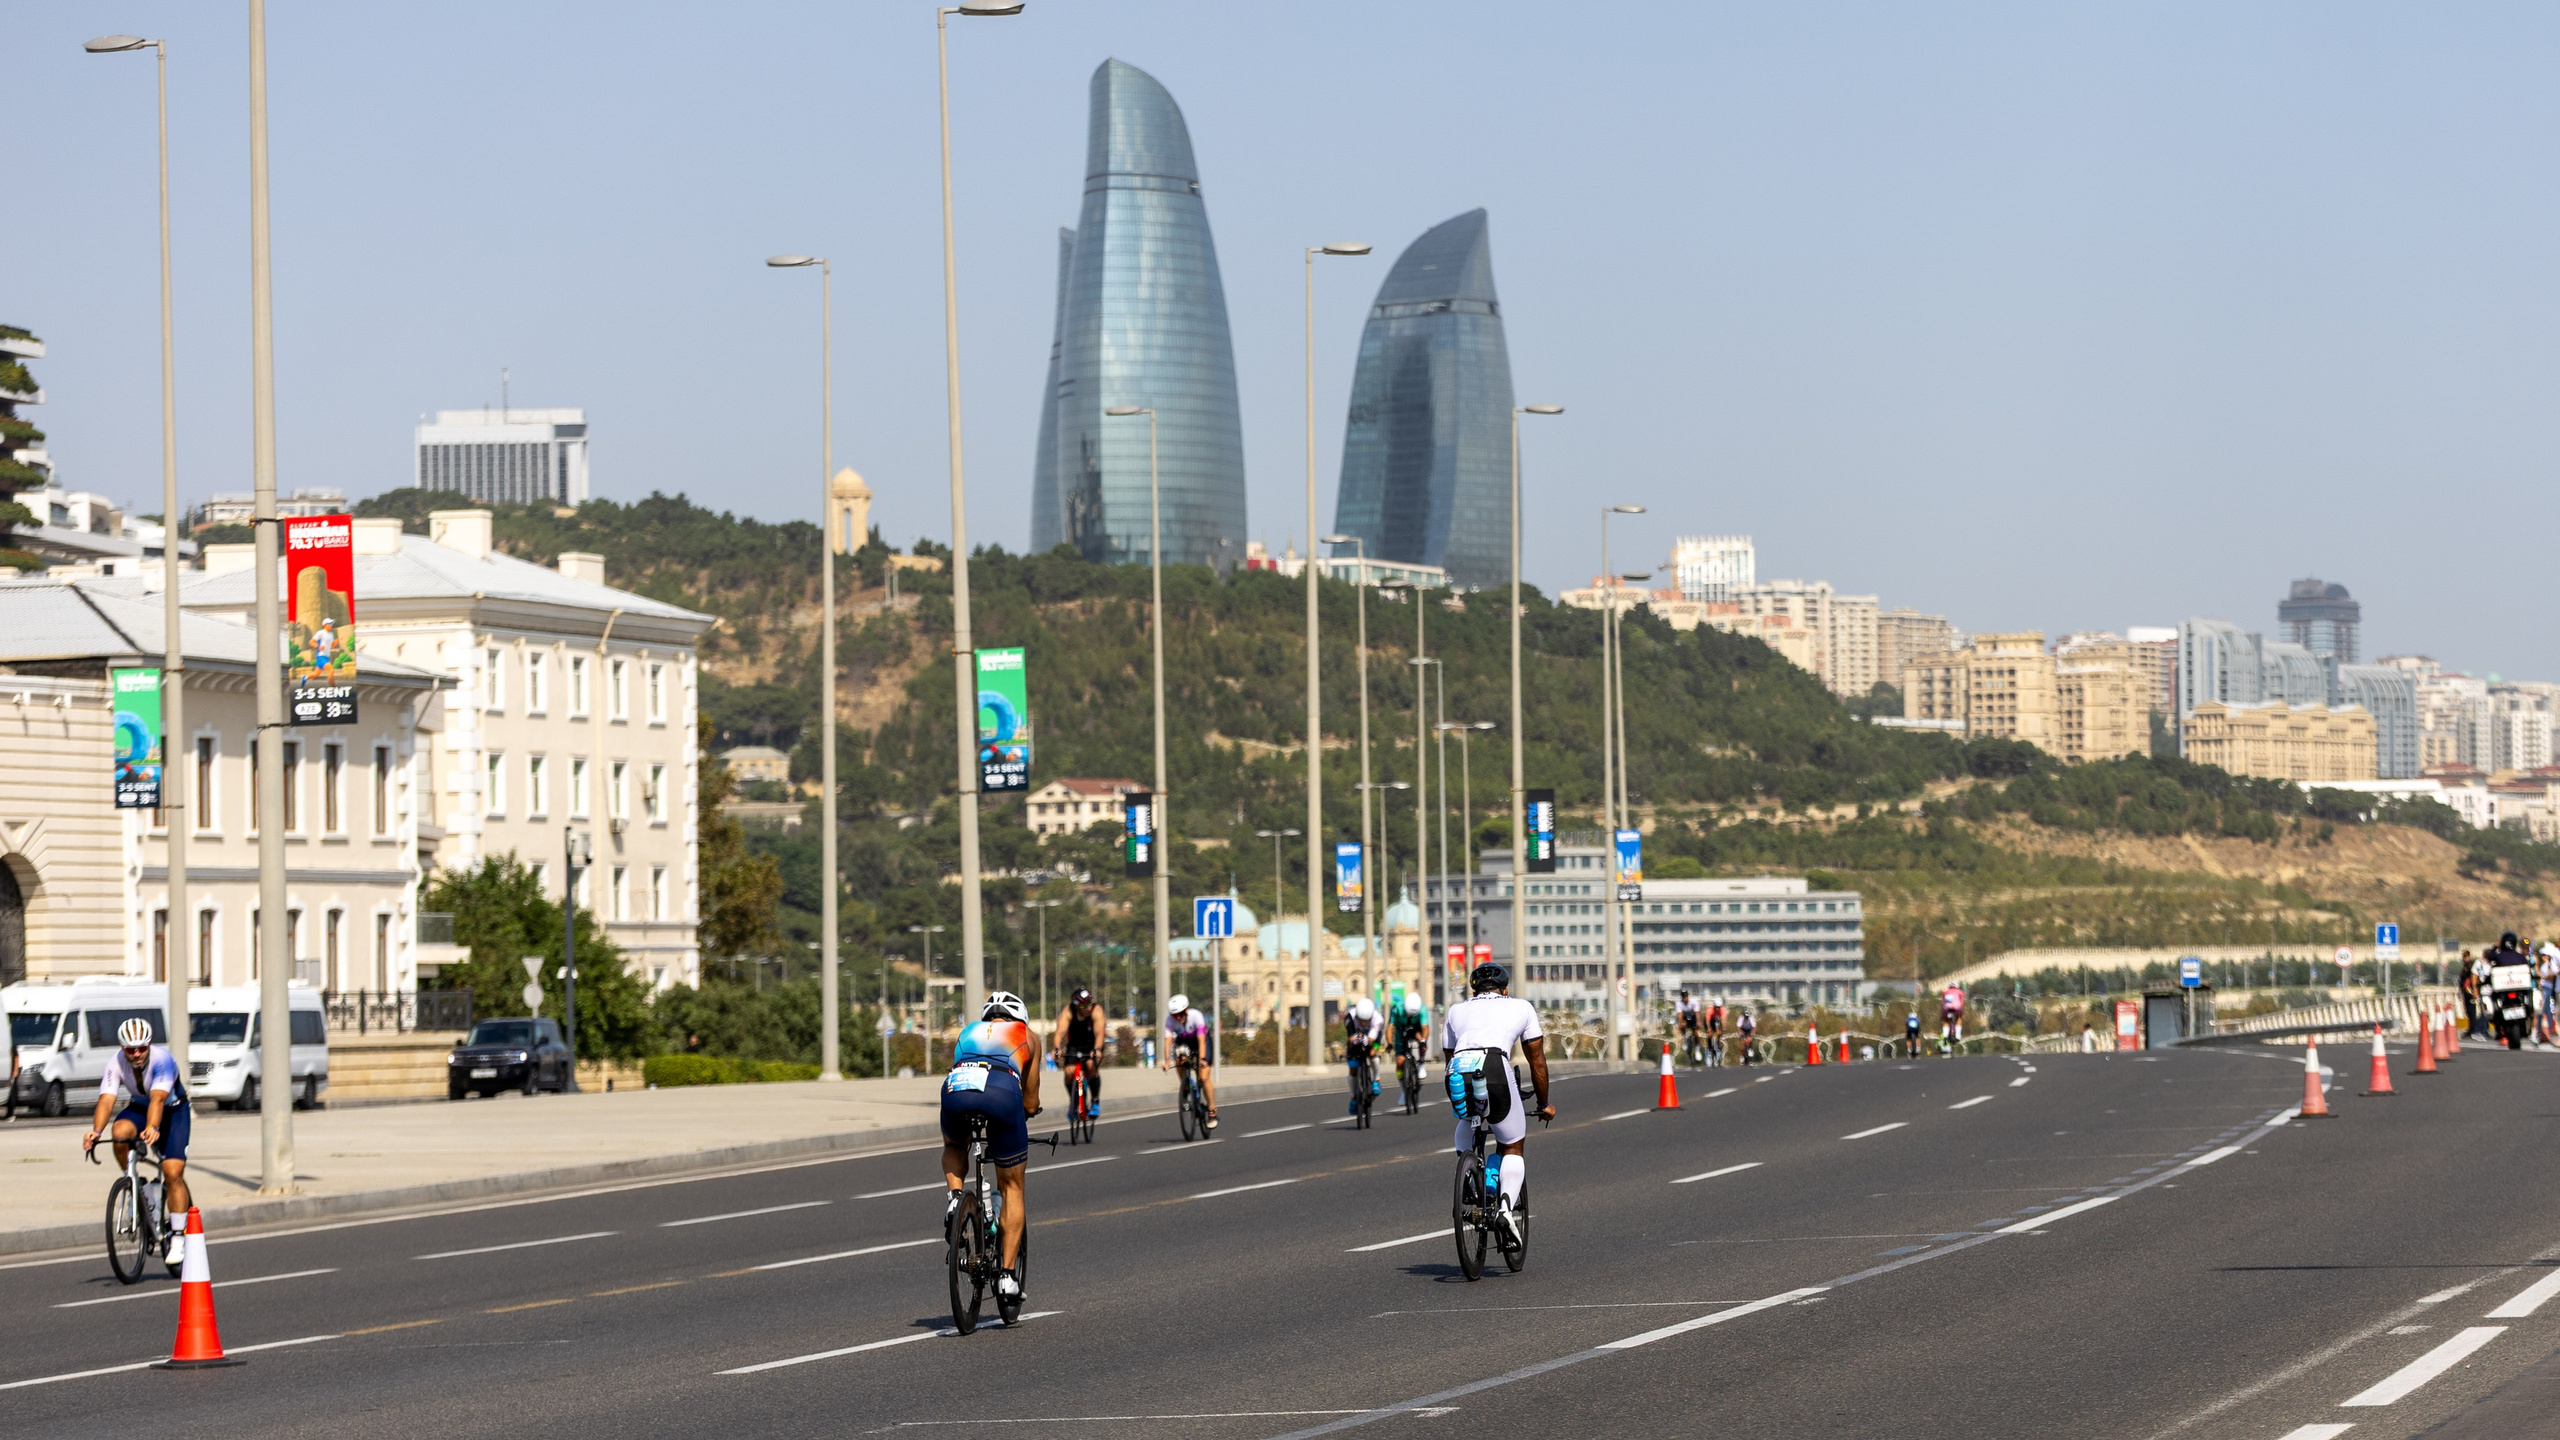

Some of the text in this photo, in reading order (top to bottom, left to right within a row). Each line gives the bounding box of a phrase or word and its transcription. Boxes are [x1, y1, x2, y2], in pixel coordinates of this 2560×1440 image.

[289, 538, 314, 550] 70.3
[294, 686, 353, 700] 3-5 SENT
[985, 762, 1026, 774] 3-5 SENT
[134, 781, 158, 792] SENT
